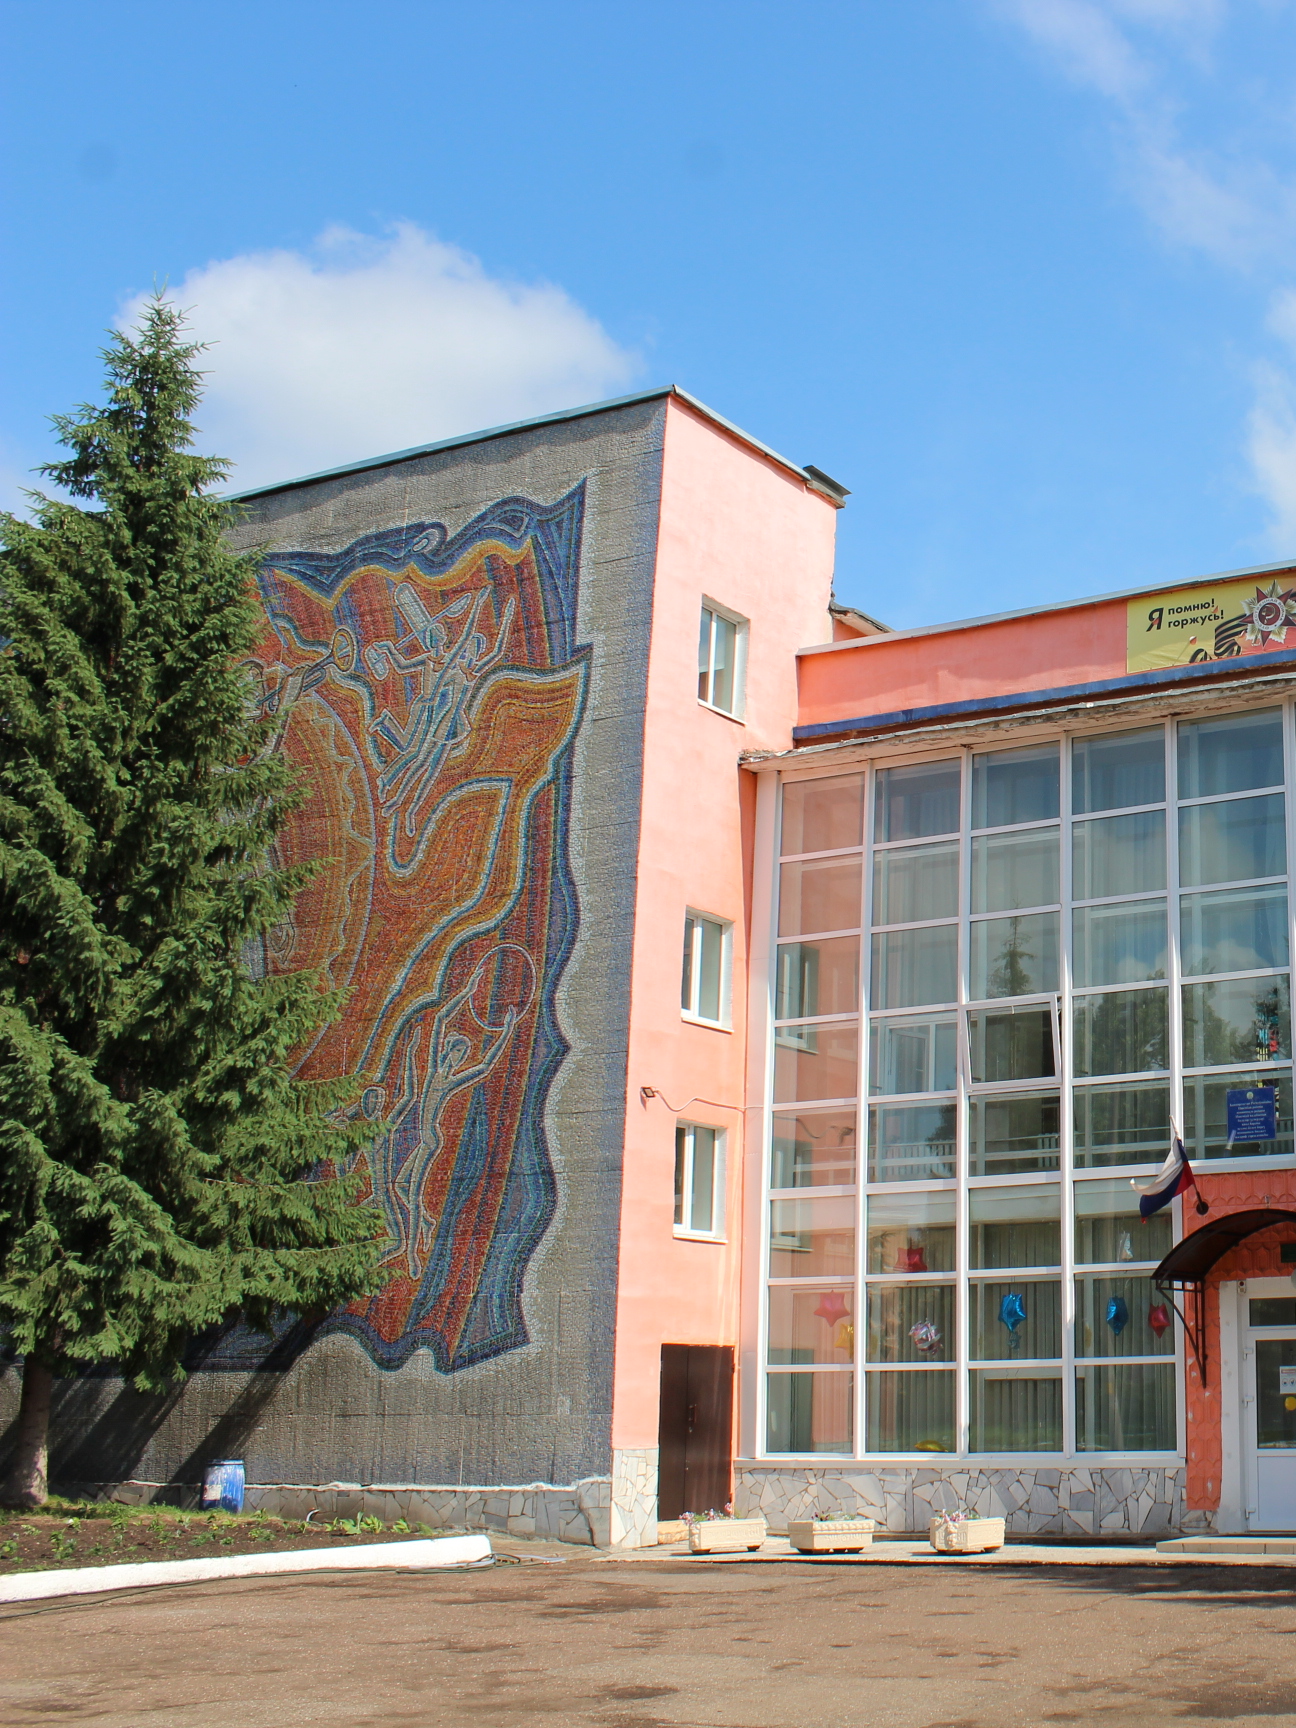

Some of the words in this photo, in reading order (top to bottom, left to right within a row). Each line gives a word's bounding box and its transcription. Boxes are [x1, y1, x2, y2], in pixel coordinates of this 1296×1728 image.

[1146, 607, 1164, 632] Я
[1168, 598, 1215, 615] помню!
[1168, 609, 1225, 629] горжусь!
